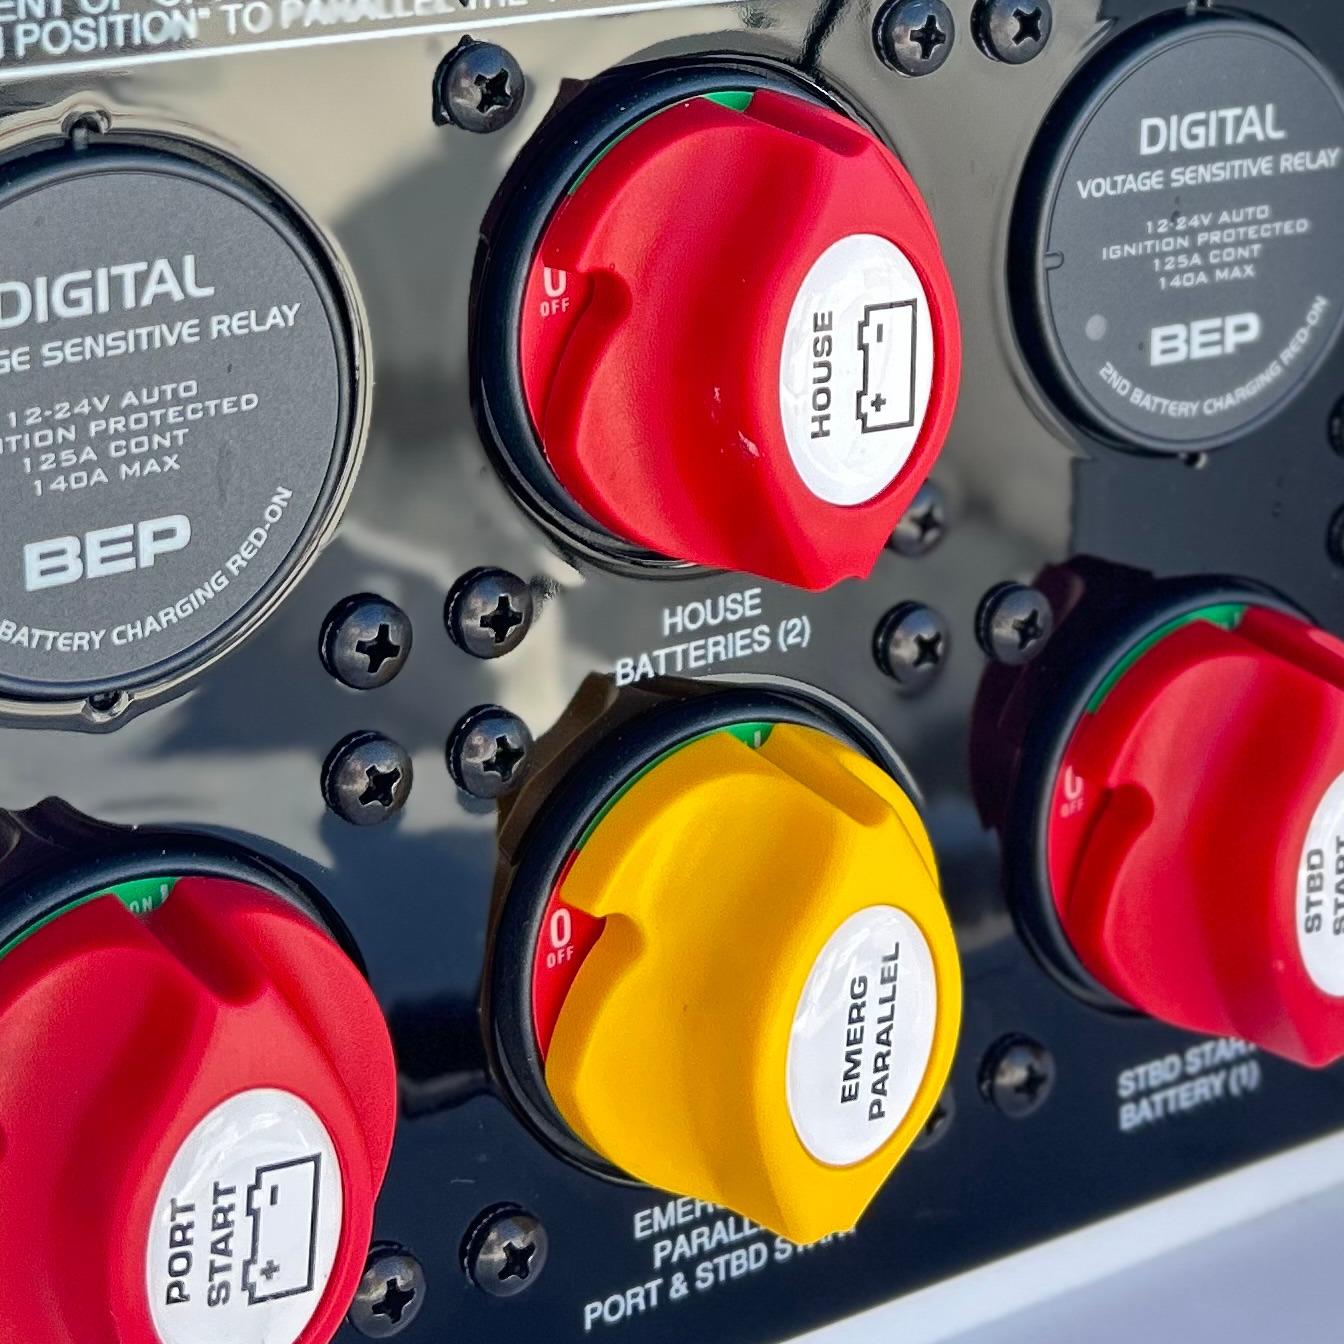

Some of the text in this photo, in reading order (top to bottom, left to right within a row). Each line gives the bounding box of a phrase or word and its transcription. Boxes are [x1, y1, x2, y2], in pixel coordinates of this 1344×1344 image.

[15, 7, 210, 59] POSITION"
[221, 2, 270, 34] TO
[1139, 103, 1287, 155] DIGITAL
[1076, 146, 1342, 199] VOLTAGE SENSITIVE RELAY
[1102, 218, 1310, 261] IGNITION PROTECTED
[1145, 205, 1270, 234] 12-24V AUTO
[1153, 243, 1263, 272] 125A CONT
[1158, 264, 1256, 290] 140A MAX
[540, 297, 570, 317] OFF
[41, 317, 201, 368] SENSITIVE
[210, 303, 302, 340] RELAY
[1098, 295, 1329, 418] 2ND BATTERY CHARGING RED-ON
[1150, 312, 1261, 367] BEP
[810, 309, 834, 440] HOUSE
[8, 380, 197, 429] 12-24V AUTO
[89, 393, 259, 438] PROTECTED
[23, 428, 190, 474] 125A CONT
[33, 454, 181, 497] 140A MAX
[24, 514, 191, 592] BEP
[110, 571, 229, 646] CHARGING
[225, 485, 294, 576] RED-ON
[662, 587, 764, 635] HOUSE
[615, 616, 812, 688] BATTERIES (2)
[1304, 847, 1325, 935] STBD
[546, 945, 574, 969] OFF
[841, 973, 870, 1105] EMERG
[868, 941, 900, 1122] PARALLEL
[1118, 1053, 1182, 1098] STBD
[1119, 1059, 1262, 1132] BATTERY (1)
[164, 1196, 196, 1305] PORT
[206, 1181, 238, 1307] START
[584, 1278, 664, 1331] PORT
[668, 1272, 689, 1300] &
[694, 1243, 768, 1291] STBD
